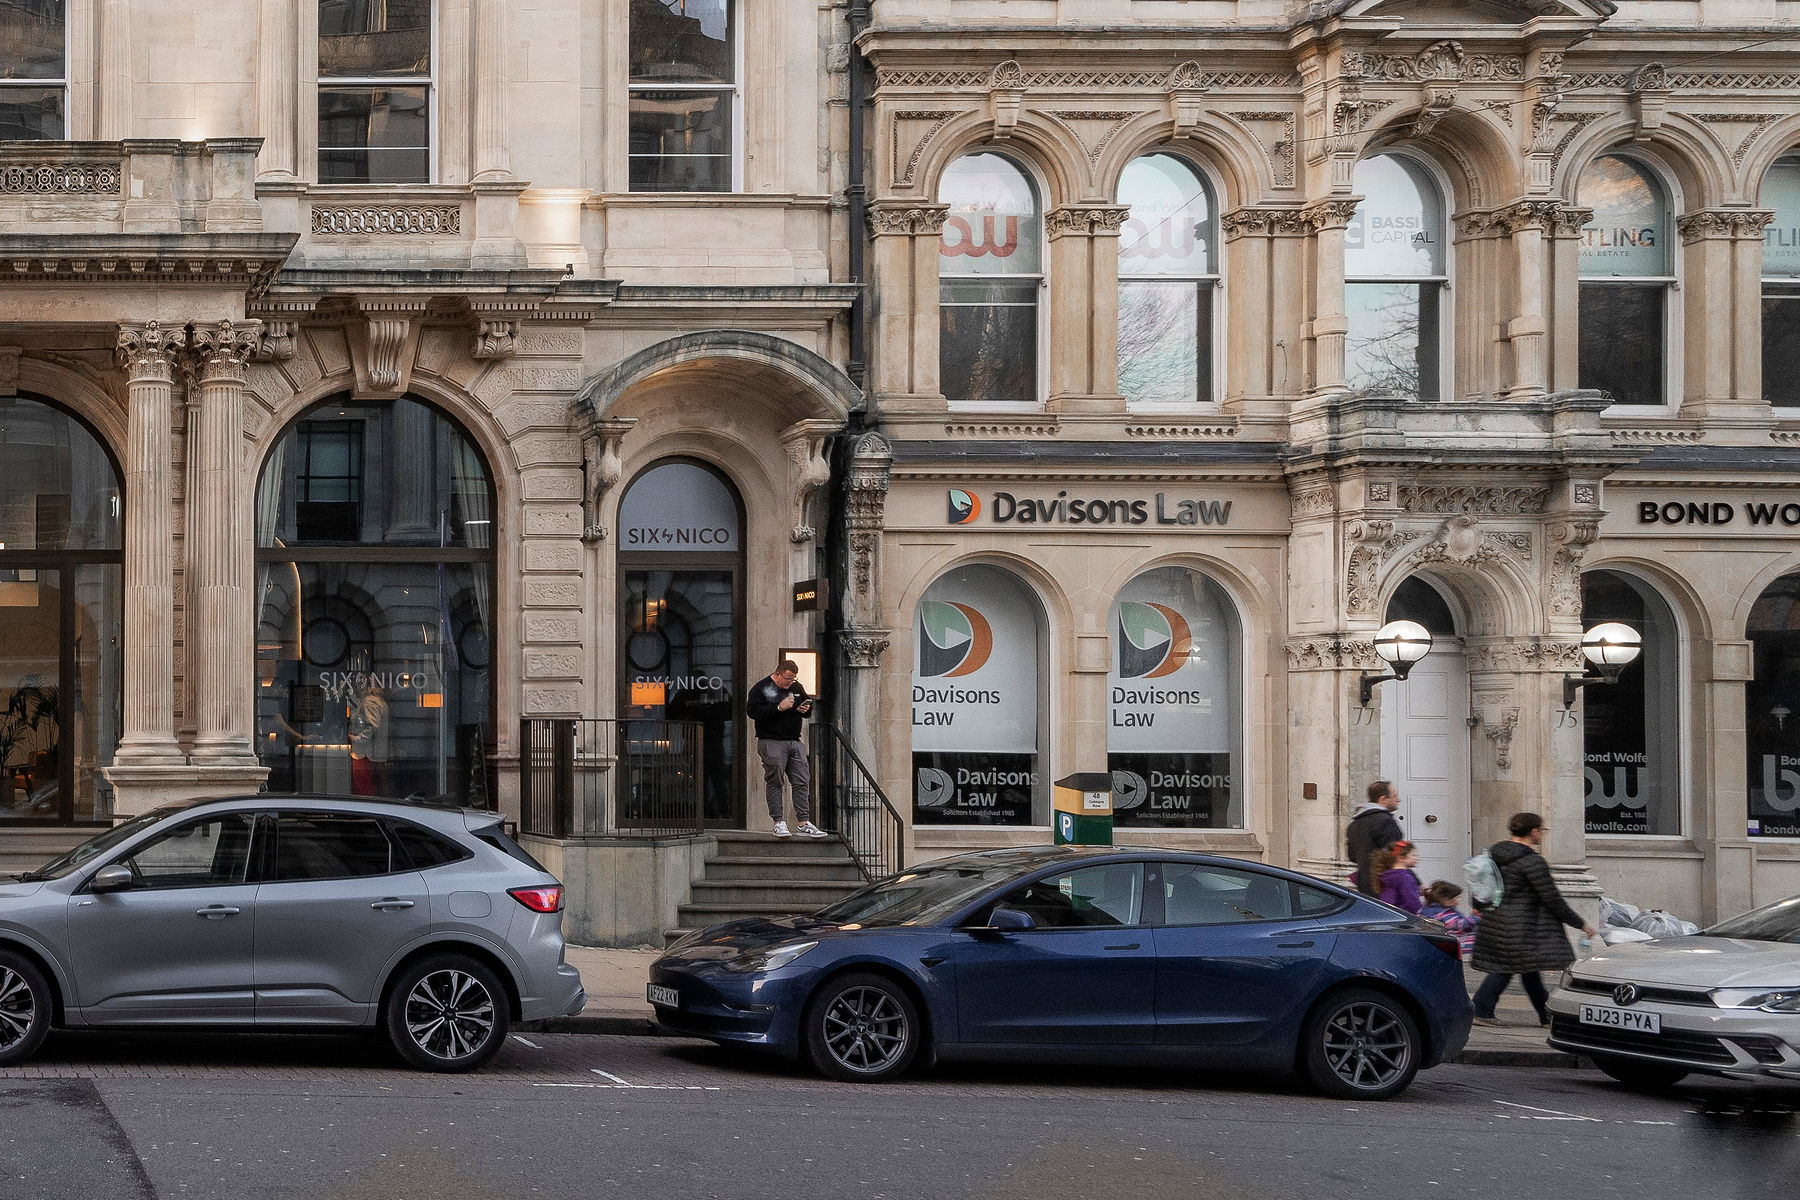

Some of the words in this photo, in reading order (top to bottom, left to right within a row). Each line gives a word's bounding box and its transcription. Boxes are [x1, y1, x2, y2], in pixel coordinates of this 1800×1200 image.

[1371, 216, 1419, 229] BASSI
[1371, 231, 1435, 243] CAPITAL
[993, 490, 1148, 524] Davisons
[1155, 492, 1232, 525] Law
[1639, 501, 1734, 525] BOND
[628, 528, 660, 544] SIX
[662, 528, 673, 544] by
[677, 528, 730, 544] NICO
[320, 671, 353, 689] SIX
[371, 672, 428, 689] NICO
[635, 676, 662, 689] SIX
[676, 676, 723, 690] NICO
[912, 685, 1001, 704] Davisons
[1112, 685, 1200, 704] Davisons
[912, 707, 954, 726] Law
[1112, 709, 1155, 727] Law
[1353, 707, 1374, 726] 77
[1555, 709, 1578, 729] 75
[1614, 752, 1648, 763] Wolfe
[957, 767, 1040, 786] Davisons
[1150, 770, 1231, 788] Davisons
[957, 788, 997, 807] Law
[1150, 791, 1191, 809] Law
[942, 809, 968, 817] Solicitors
[969, 809, 1000, 817] Established
[1136, 811, 1161, 819] Solicitors
[1162, 812, 1194, 820] Established
[1062, 816, 1071, 836] P
[1585, 1007, 1620, 1025] BJ23
[1623, 1012, 1653, 1030] PYA
